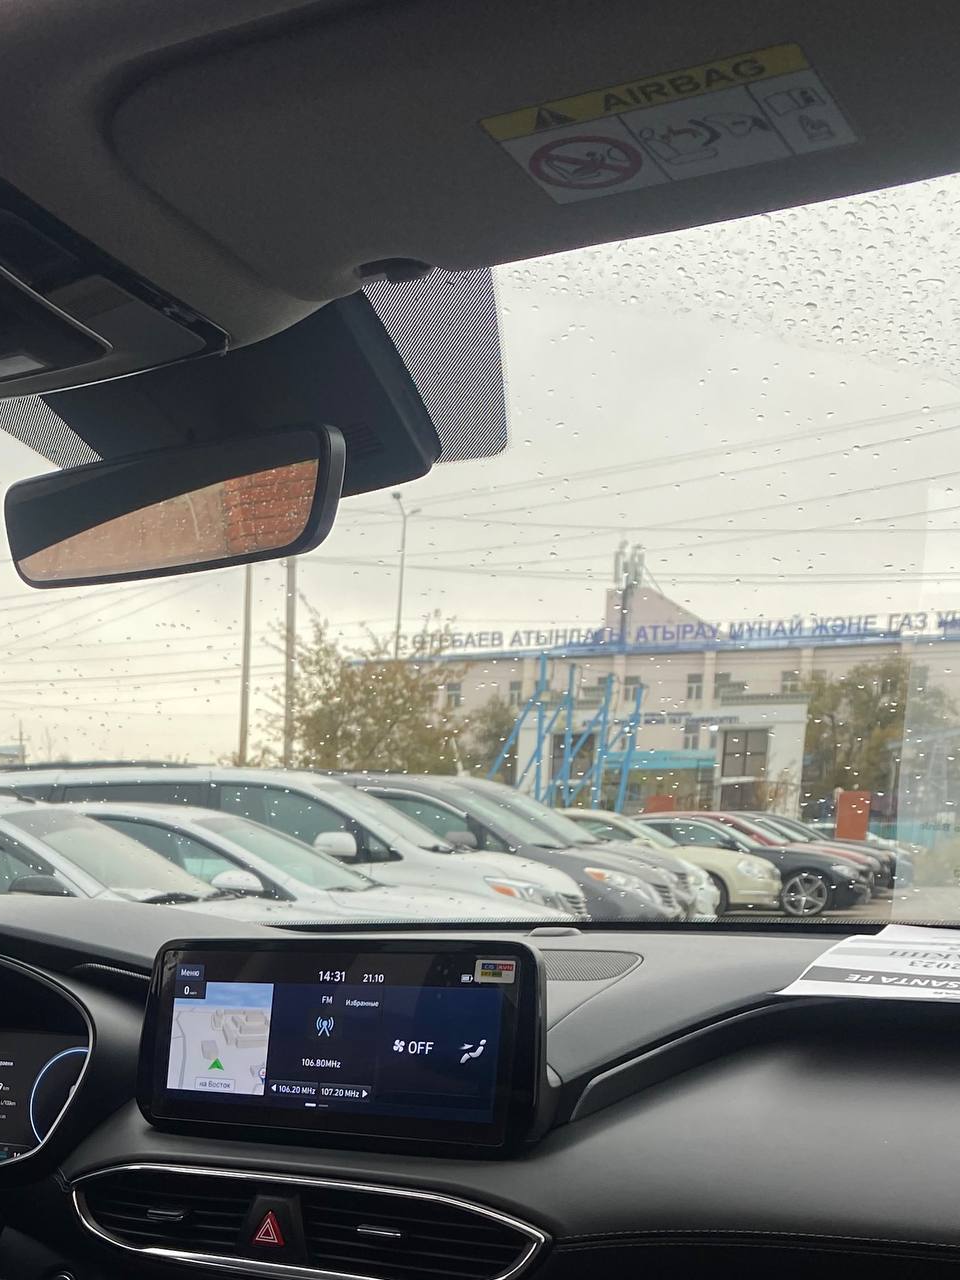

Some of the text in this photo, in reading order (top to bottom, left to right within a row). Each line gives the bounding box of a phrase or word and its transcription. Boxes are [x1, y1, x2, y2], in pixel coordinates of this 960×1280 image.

[602, 57, 766, 113] AIRBAG
[888, 611, 928, 633] ГАЗ
[180, 968, 200, 977] Меню
[318, 970, 385, 983] 14:31 21.10
[844, 973, 960, 989] SANTA FE
[321, 995, 333, 1004] FM
[345, 999, 379, 1008] Избранные
[408, 1040, 434, 1055] OFF
[301, 1058, 341, 1069] 106.80MHz
[278, 1084, 316, 1095] 106.20 MHz
[321, 1087, 360, 1098] 107.20 MHz
